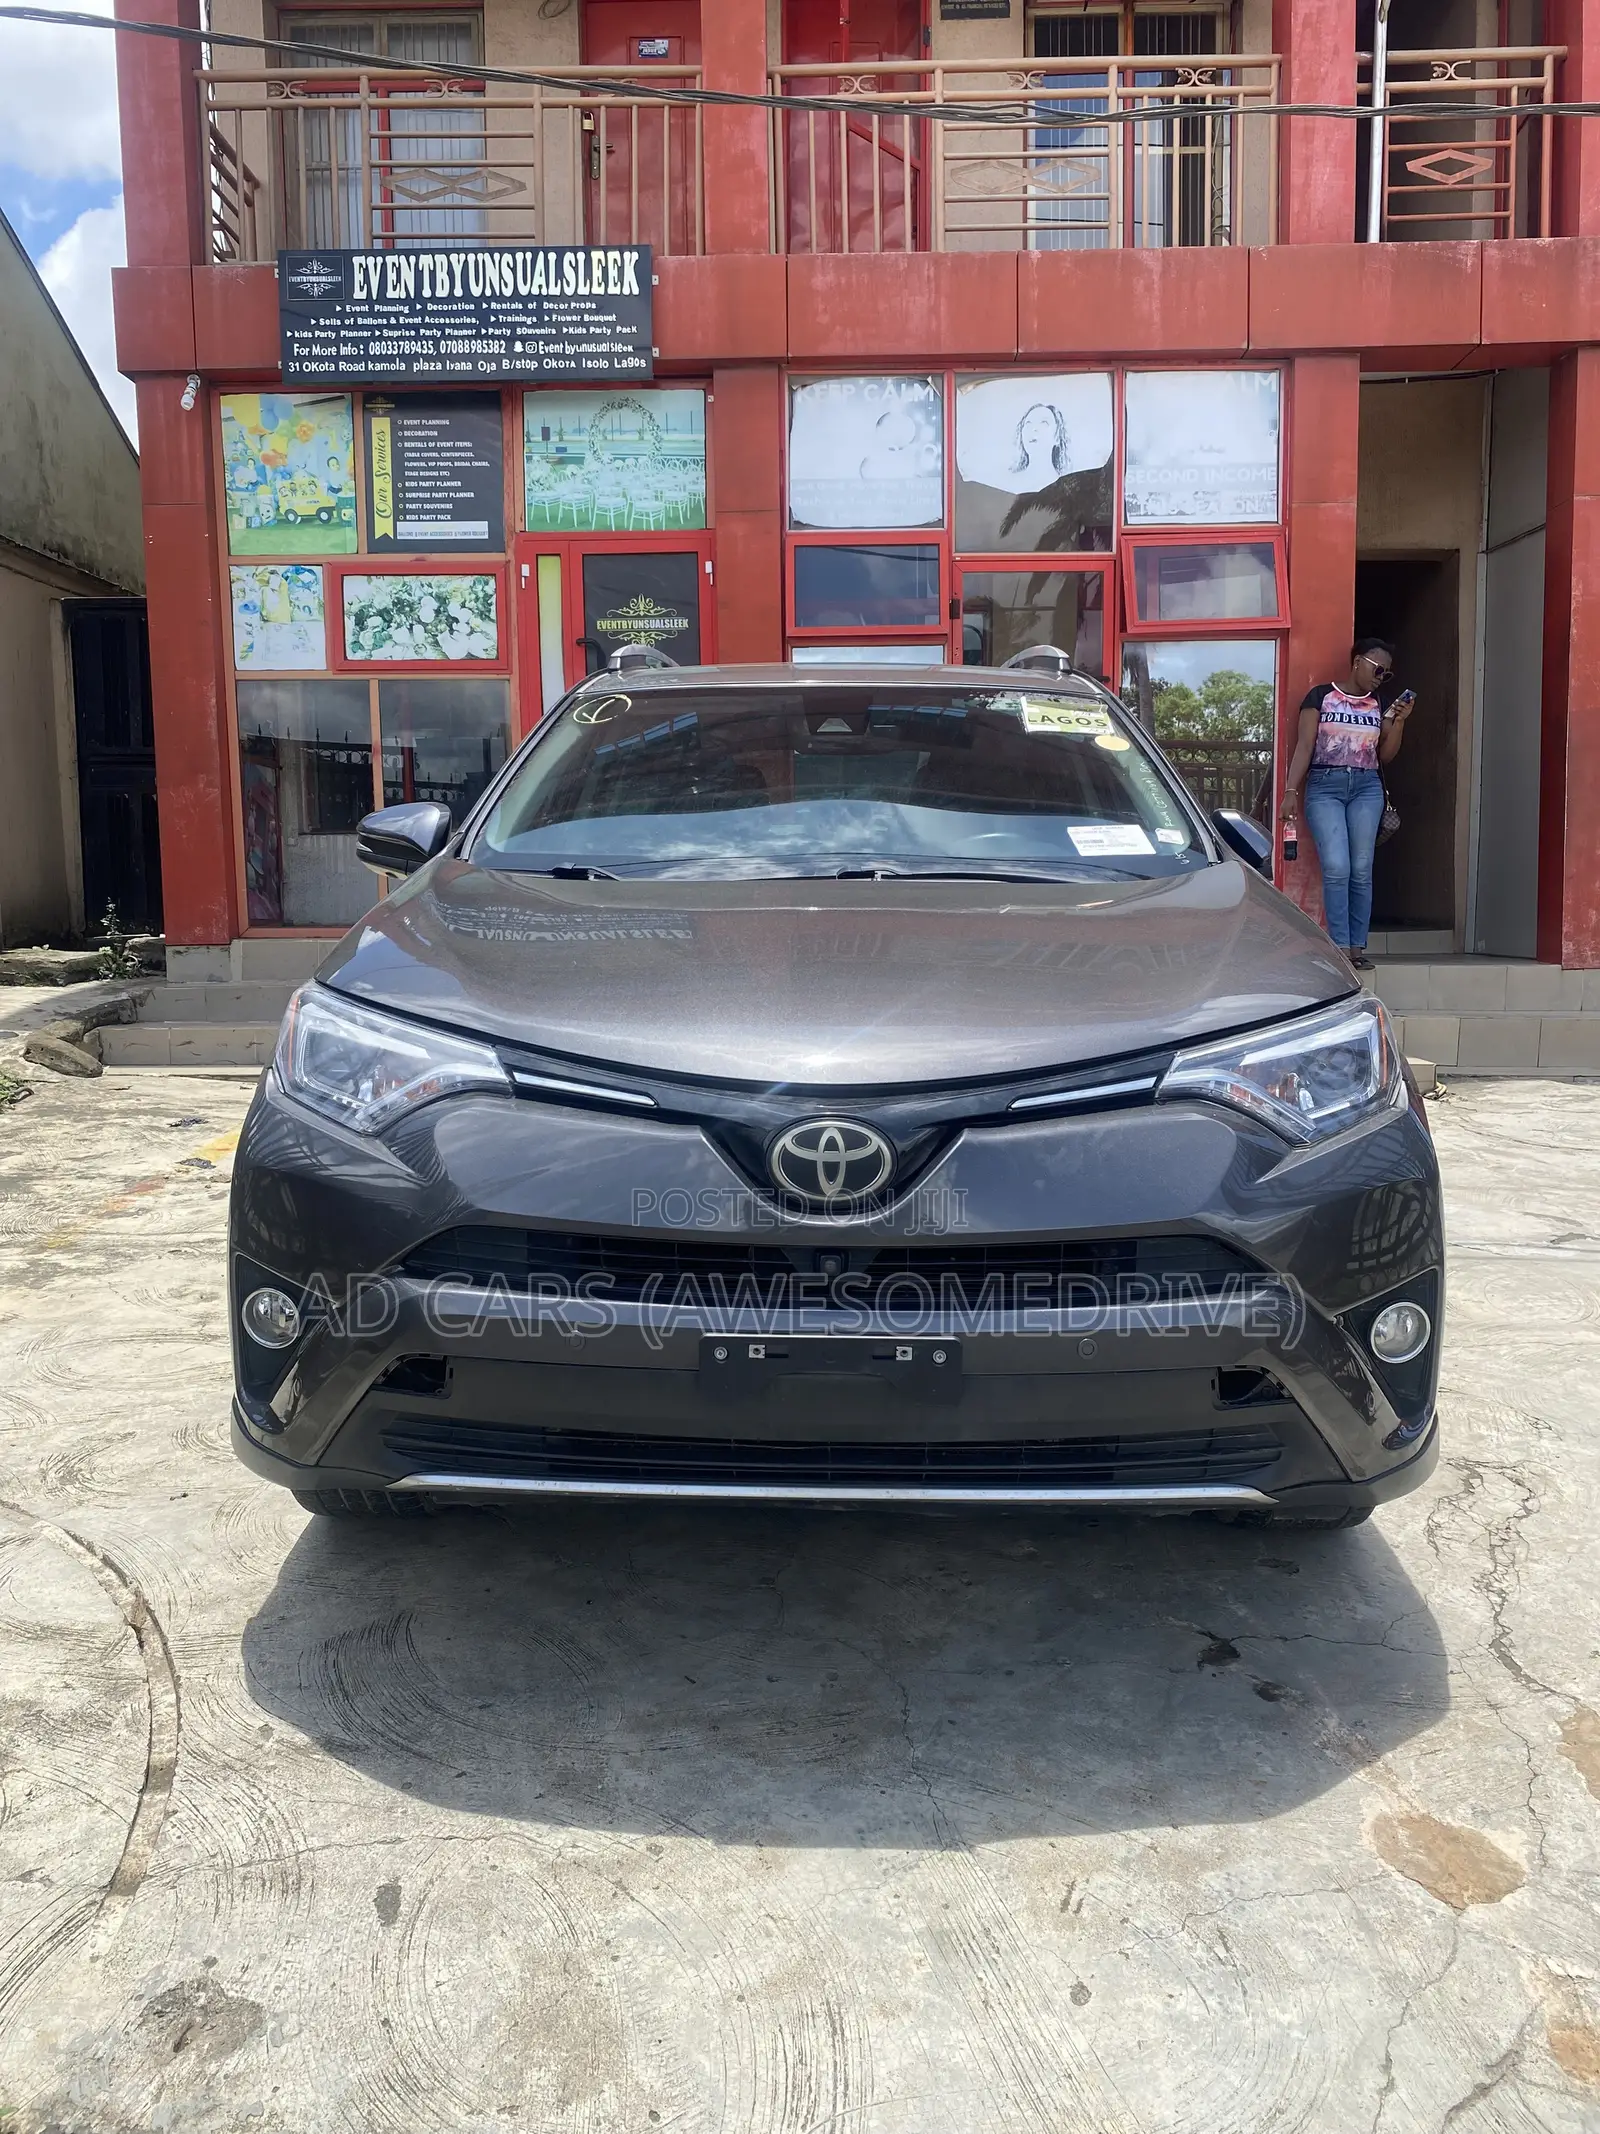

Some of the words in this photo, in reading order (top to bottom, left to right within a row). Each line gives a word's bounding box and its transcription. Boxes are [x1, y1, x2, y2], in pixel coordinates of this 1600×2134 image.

[352, 251, 640, 300] EVENTBYUNSUALSLEEK
[375, 304, 410, 313] Planning
[427, 302, 475, 311] Decoration
[491, 302, 523, 310] Rentals
[543, 302, 568, 310] Decor
[571, 302, 596, 310] Props
[345, 317, 354, 325] of
[358, 317, 387, 325] Ballons
[400, 316, 422, 324] Event
[425, 316, 479, 325] Accessories,
[553, 314, 581, 322] Flower
[584, 314, 617, 322] Bouquet
[315, 331, 336, 339] Party
[383, 329, 415, 337] Suprise
[420, 329, 441, 337] Party
[445, 328, 476, 336] Planner
[488, 328, 511, 336] Party
[569, 326, 587, 334] Kids
[590, 327, 611, 335] Party
[294, 344, 309, 356] For
[312, 343, 337, 356] More
[368, 340, 437, 355] 08033789435,
[440, 340, 506, 354] 07088985382
[288, 362, 300, 372] 31
[339, 361, 365, 372] Road
[368, 358, 406, 371] kamola
[413, 357, 442, 373] plaza
[478, 360, 497, 373] Oja
[582, 358, 609, 369] Isolo
[614, 357, 647, 369] Lagos
[863, 383, 934, 402] CALM
[375, 428, 391, 484] Services
[1126, 468, 1199, 484] SECOND
[1205, 466, 1276, 483] INCOME
[376, 487, 392, 518] Our
[597, 618, 689, 630] EVENTBYUNSUALSLEEK
[1028, 714, 1107, 727] LAGOS
